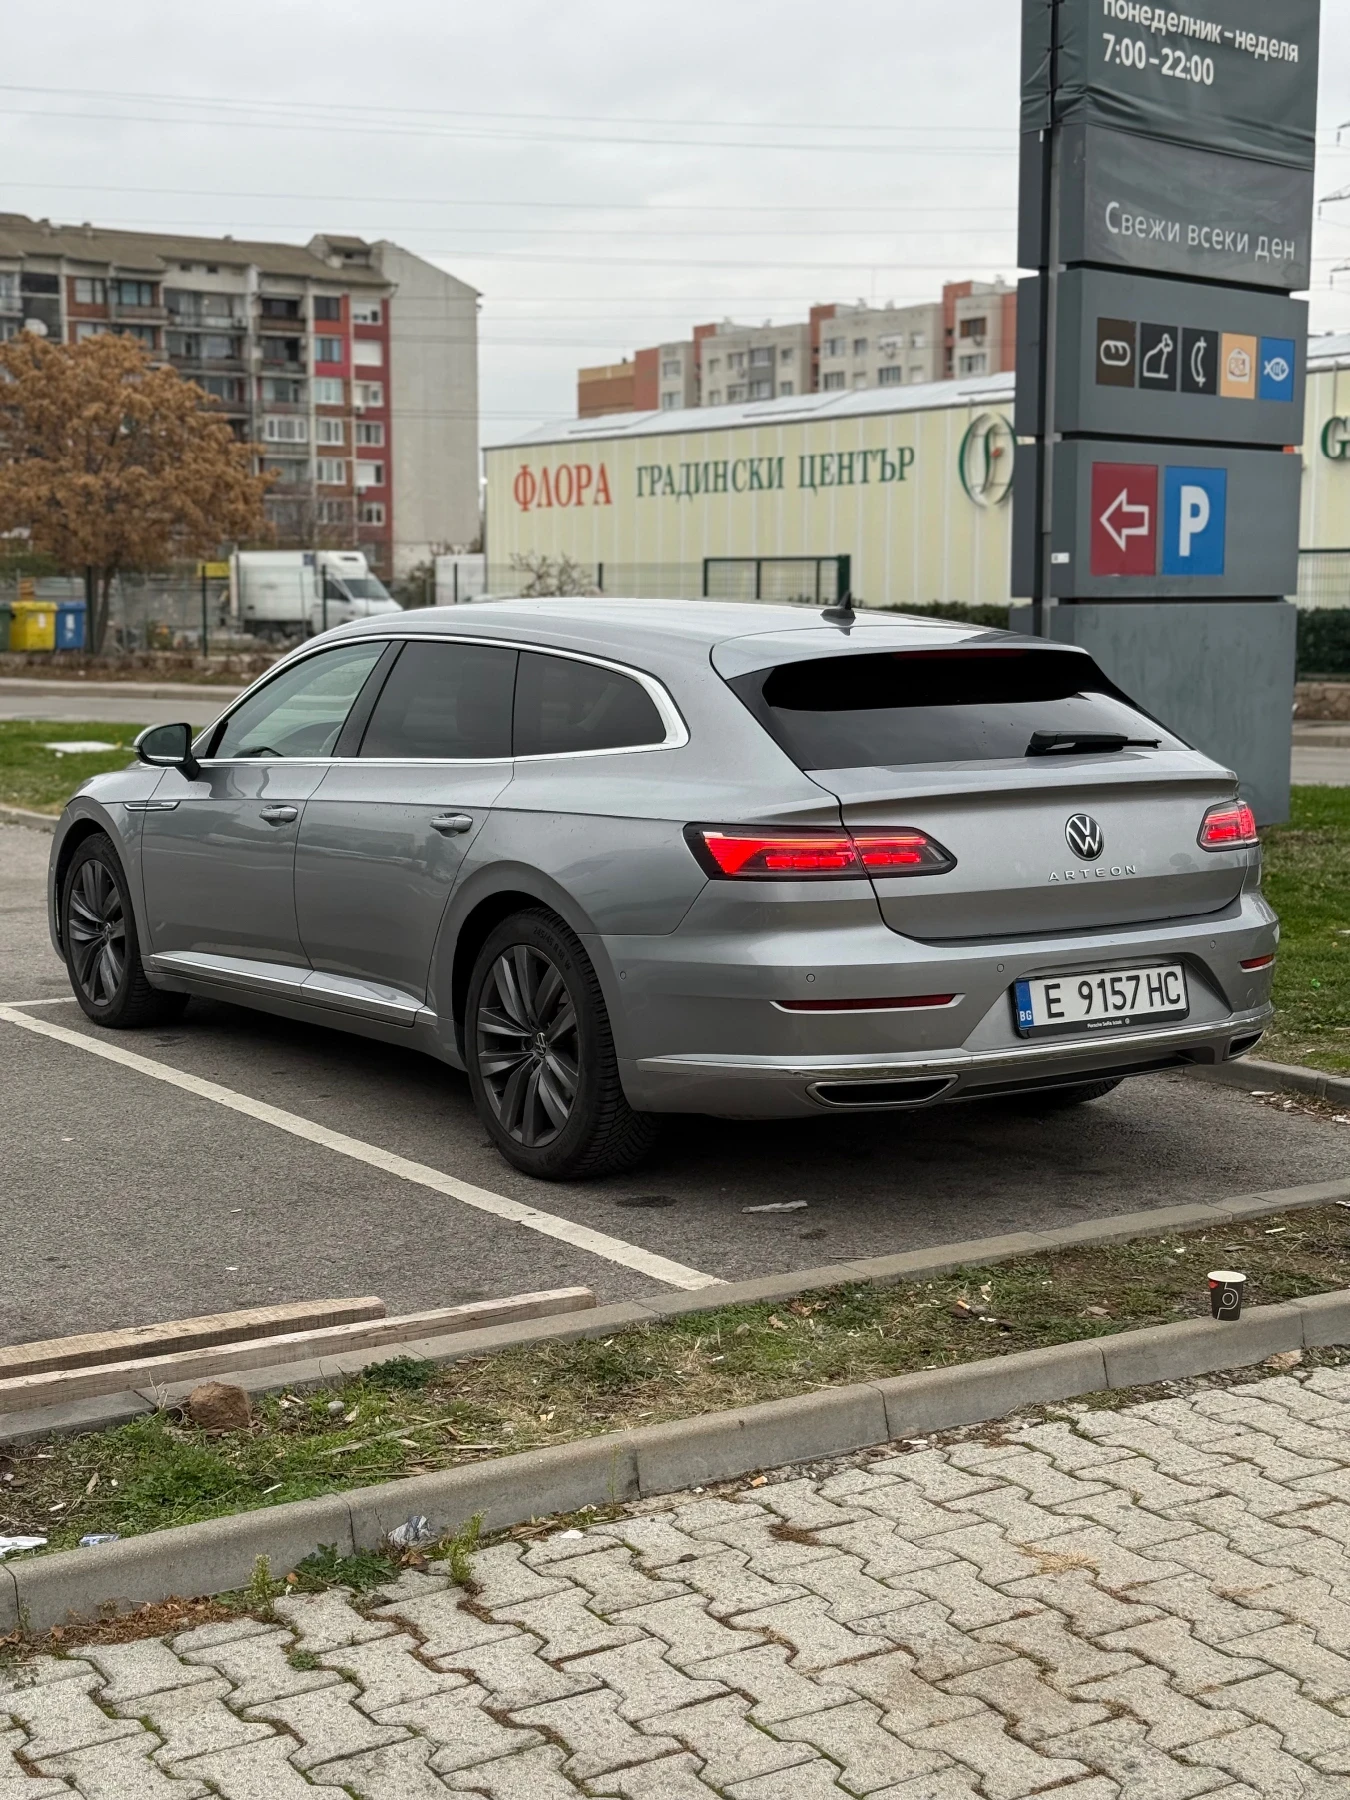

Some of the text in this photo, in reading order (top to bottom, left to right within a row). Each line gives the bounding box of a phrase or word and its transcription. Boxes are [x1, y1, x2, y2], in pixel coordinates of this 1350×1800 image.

[1104, 201, 1295, 263] Свежи всеки ден
[513, 445, 916, 512] ФЛОРА ГРАДИНСКИ ЦЕНТЪР
[1178, 485, 1210, 557] P
[1047, 864, 1138, 882] ARTEON
[1019, 1010, 1032, 1021] BG
